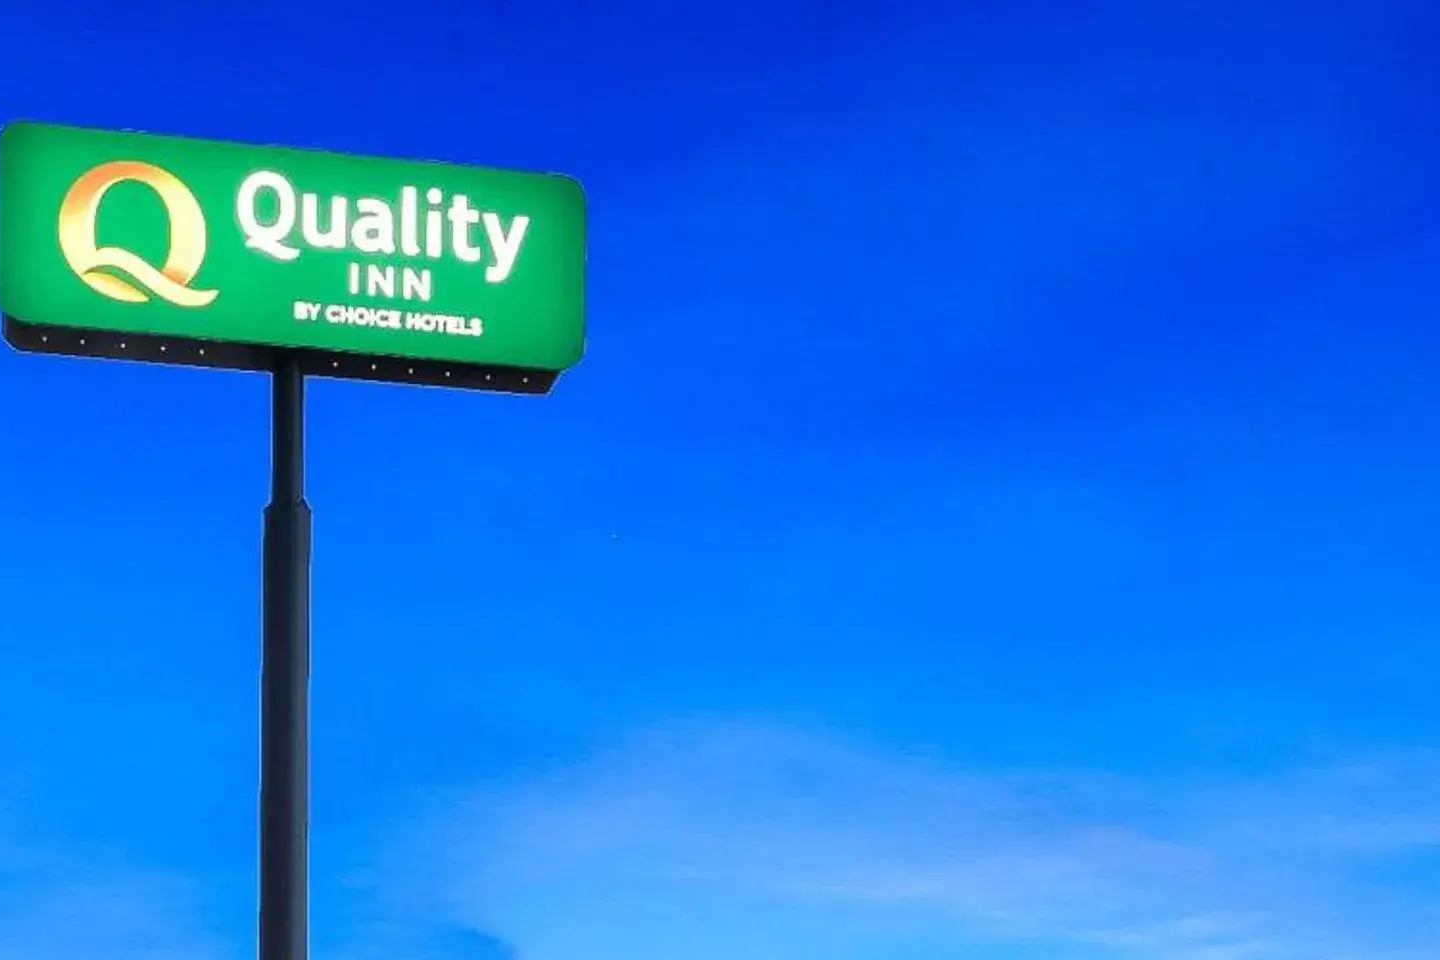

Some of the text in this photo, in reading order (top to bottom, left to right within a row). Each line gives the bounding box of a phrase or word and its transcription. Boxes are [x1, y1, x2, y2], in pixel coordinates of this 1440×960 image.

[58, 160, 220, 307] Q
[235, 169, 531, 283] Quality
[293, 300, 483, 337] BY CHOICE HOTELS
[347, 261, 434, 302] INN
